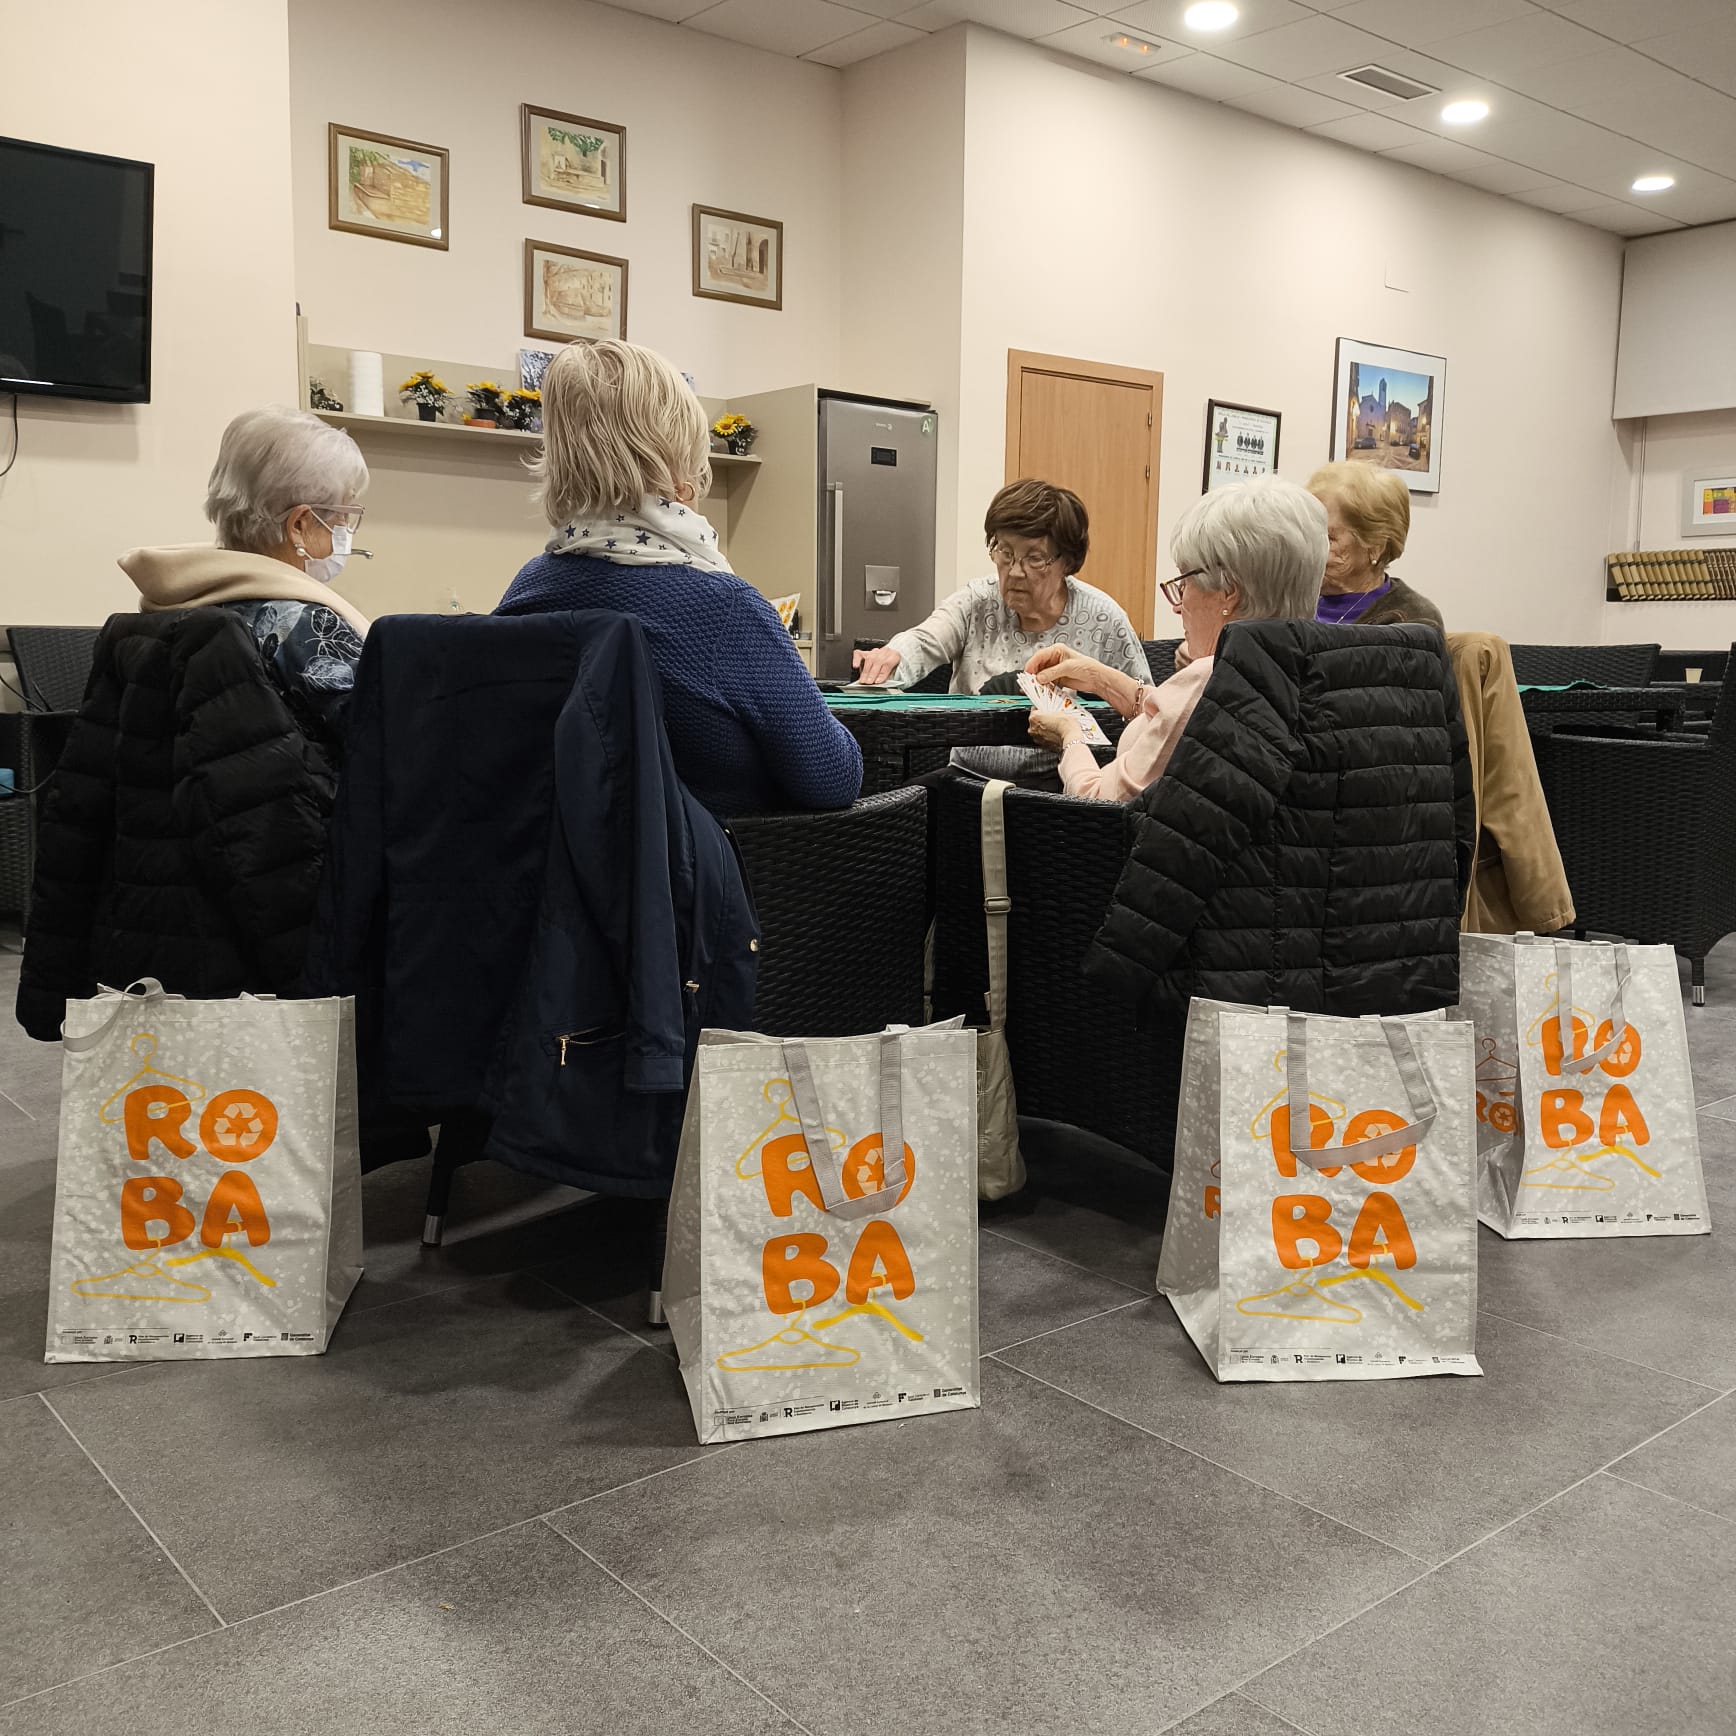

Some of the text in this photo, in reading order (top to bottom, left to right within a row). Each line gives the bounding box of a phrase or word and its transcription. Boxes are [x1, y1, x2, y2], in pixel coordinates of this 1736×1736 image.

[124, 1085, 279, 1163] RO
[1540, 1083, 1651, 1149] BA
[120, 1169, 271, 1250] BA
[761, 1132, 916, 1217] RO
[762, 1220, 916, 1315] BA
[1271, 1191, 1417, 1270] BA
